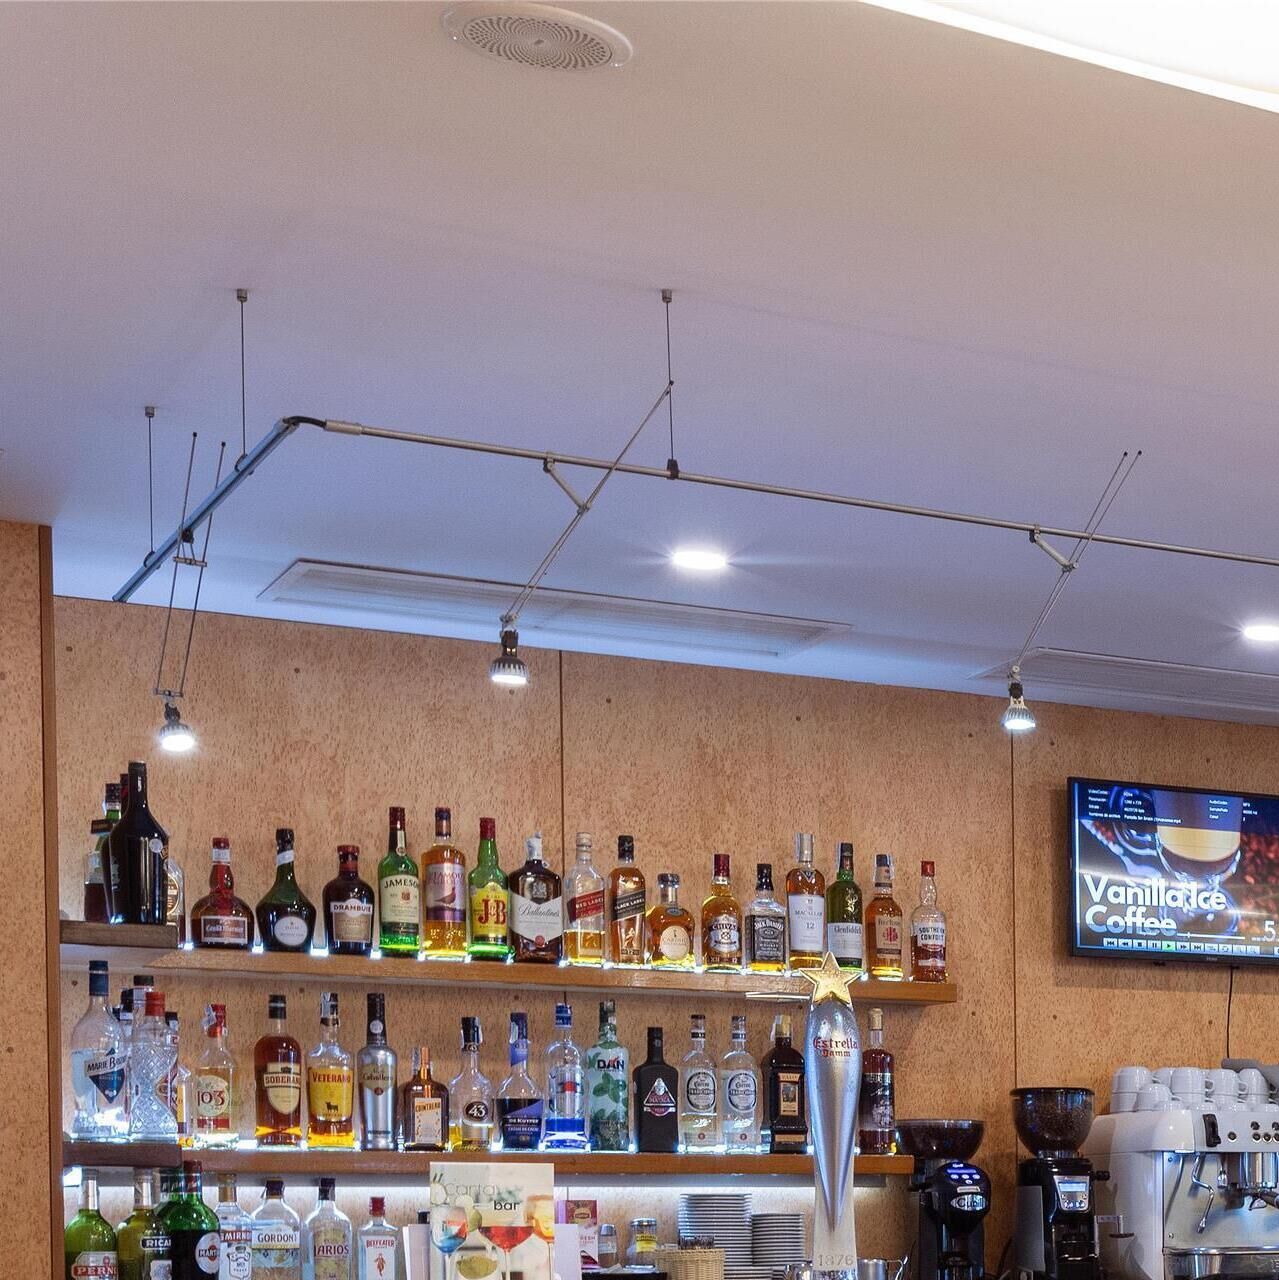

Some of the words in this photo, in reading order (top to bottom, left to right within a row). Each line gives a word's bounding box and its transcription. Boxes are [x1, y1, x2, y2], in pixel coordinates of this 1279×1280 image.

[1084, 874, 1184, 907] Vanilla
[1190, 881, 1227, 910] Ice
[333, 904, 372, 912] DRAMBUIE
[1085, 905, 1177, 937] Coffee
[813, 1036, 858, 1049] Estrella
[597, 1058, 624, 1070] DAN
[197, 1090, 225, 1106] 103
[468, 1105, 486, 1117] 43
[493, 1200, 520, 1211] bar
[366, 1239, 395, 1248] BEEFEATER
